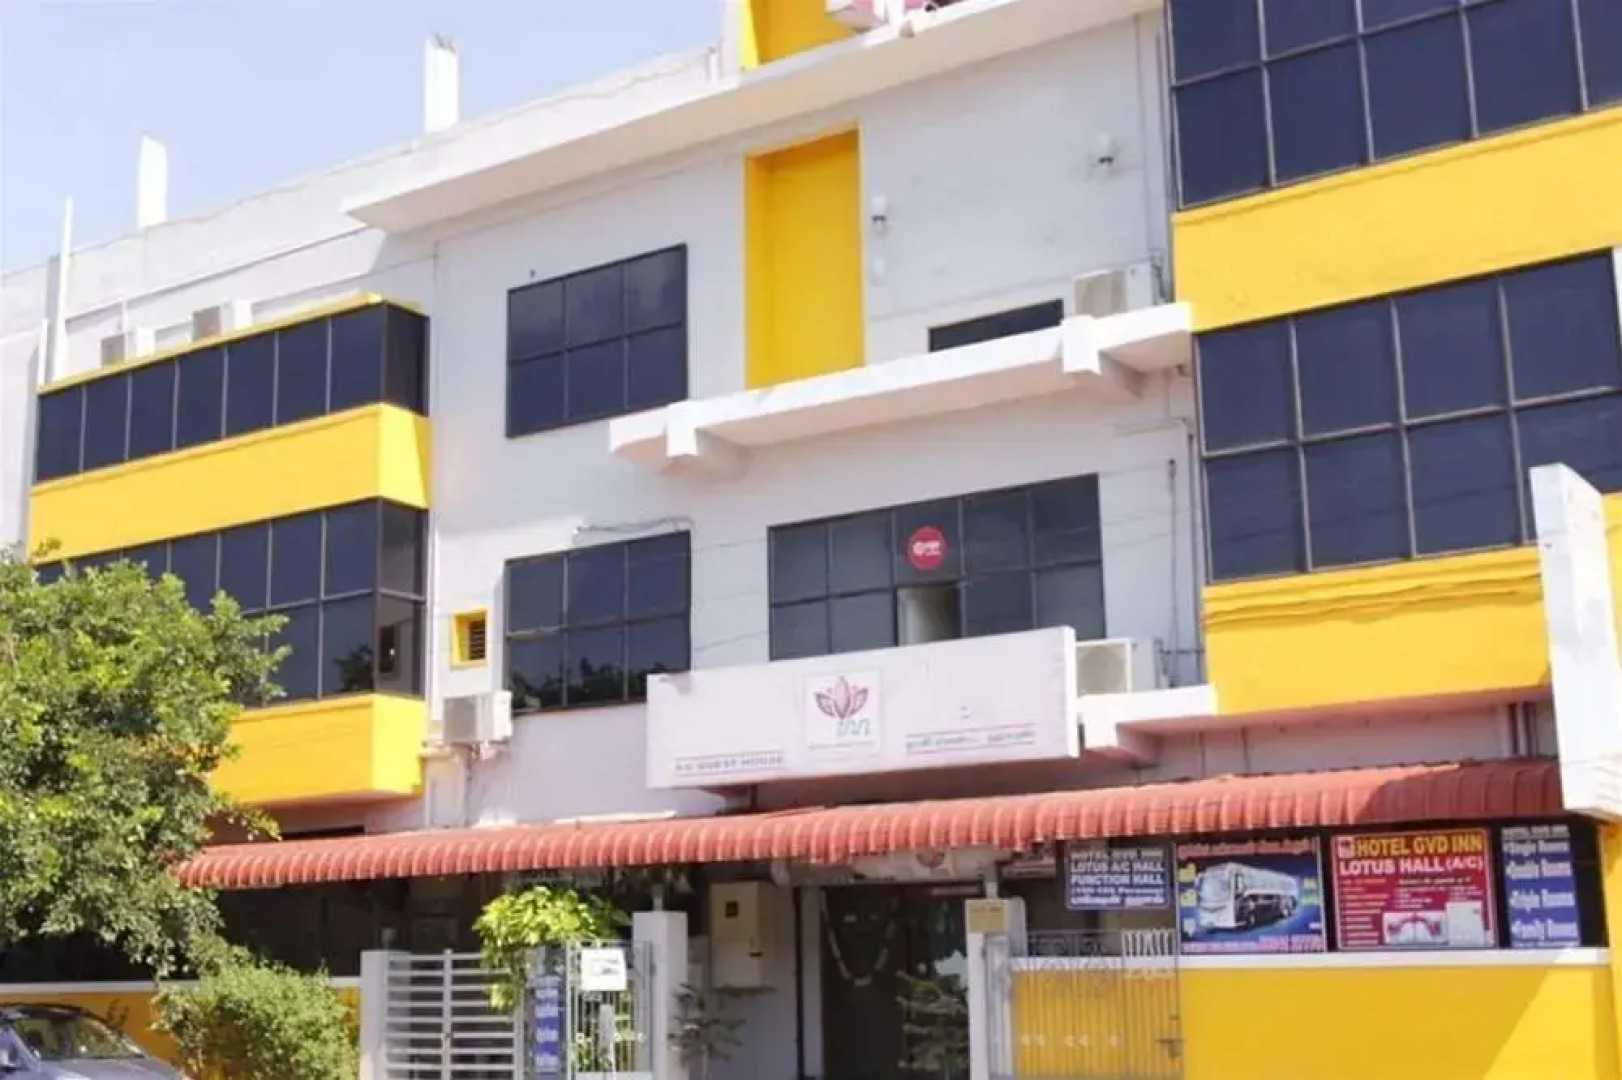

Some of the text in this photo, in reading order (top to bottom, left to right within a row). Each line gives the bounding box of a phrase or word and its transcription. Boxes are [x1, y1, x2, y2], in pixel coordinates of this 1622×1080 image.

[1357, 833, 1482, 857] HOTEL GVD INN
[1071, 861, 1109, 873] LOTUS
[1133, 860, 1164, 872] HALL
[1340, 855, 1484, 876] LOTUS HALL (A/C)
[1071, 873, 1164, 885] FUNCTION HALL
